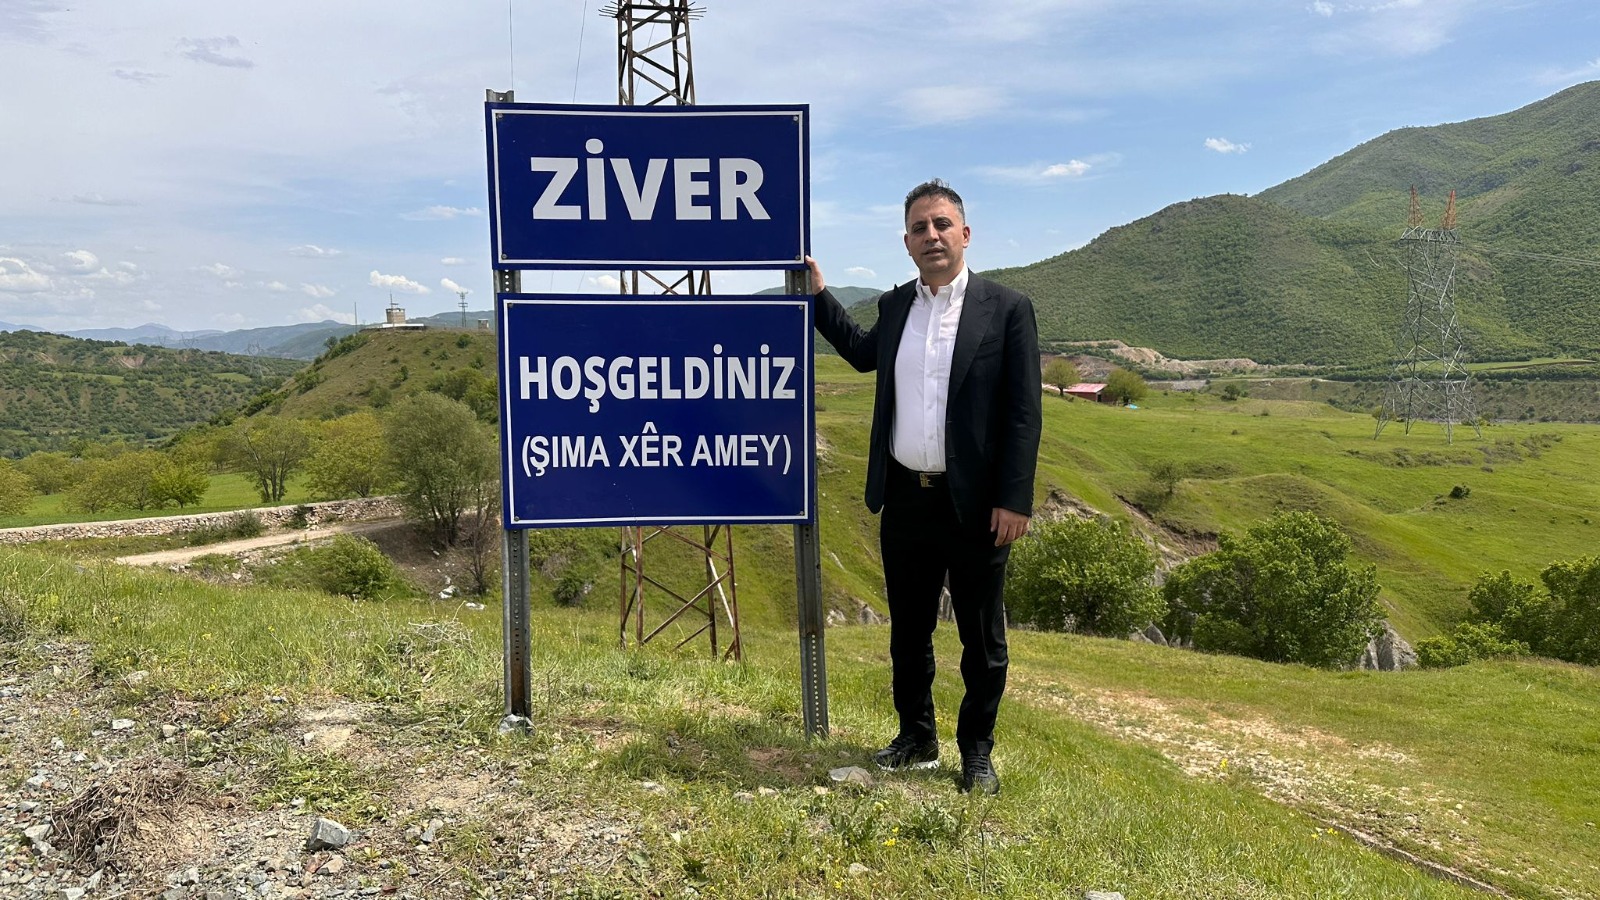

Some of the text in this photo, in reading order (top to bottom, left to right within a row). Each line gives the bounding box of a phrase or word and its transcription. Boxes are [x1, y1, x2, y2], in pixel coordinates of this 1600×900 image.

[530, 138, 771, 221] ZİVER
[519, 343, 796, 413] HOŞGELDİNİZ
[521, 421, 792, 477] (ŞIMA XÊR AMEY)
